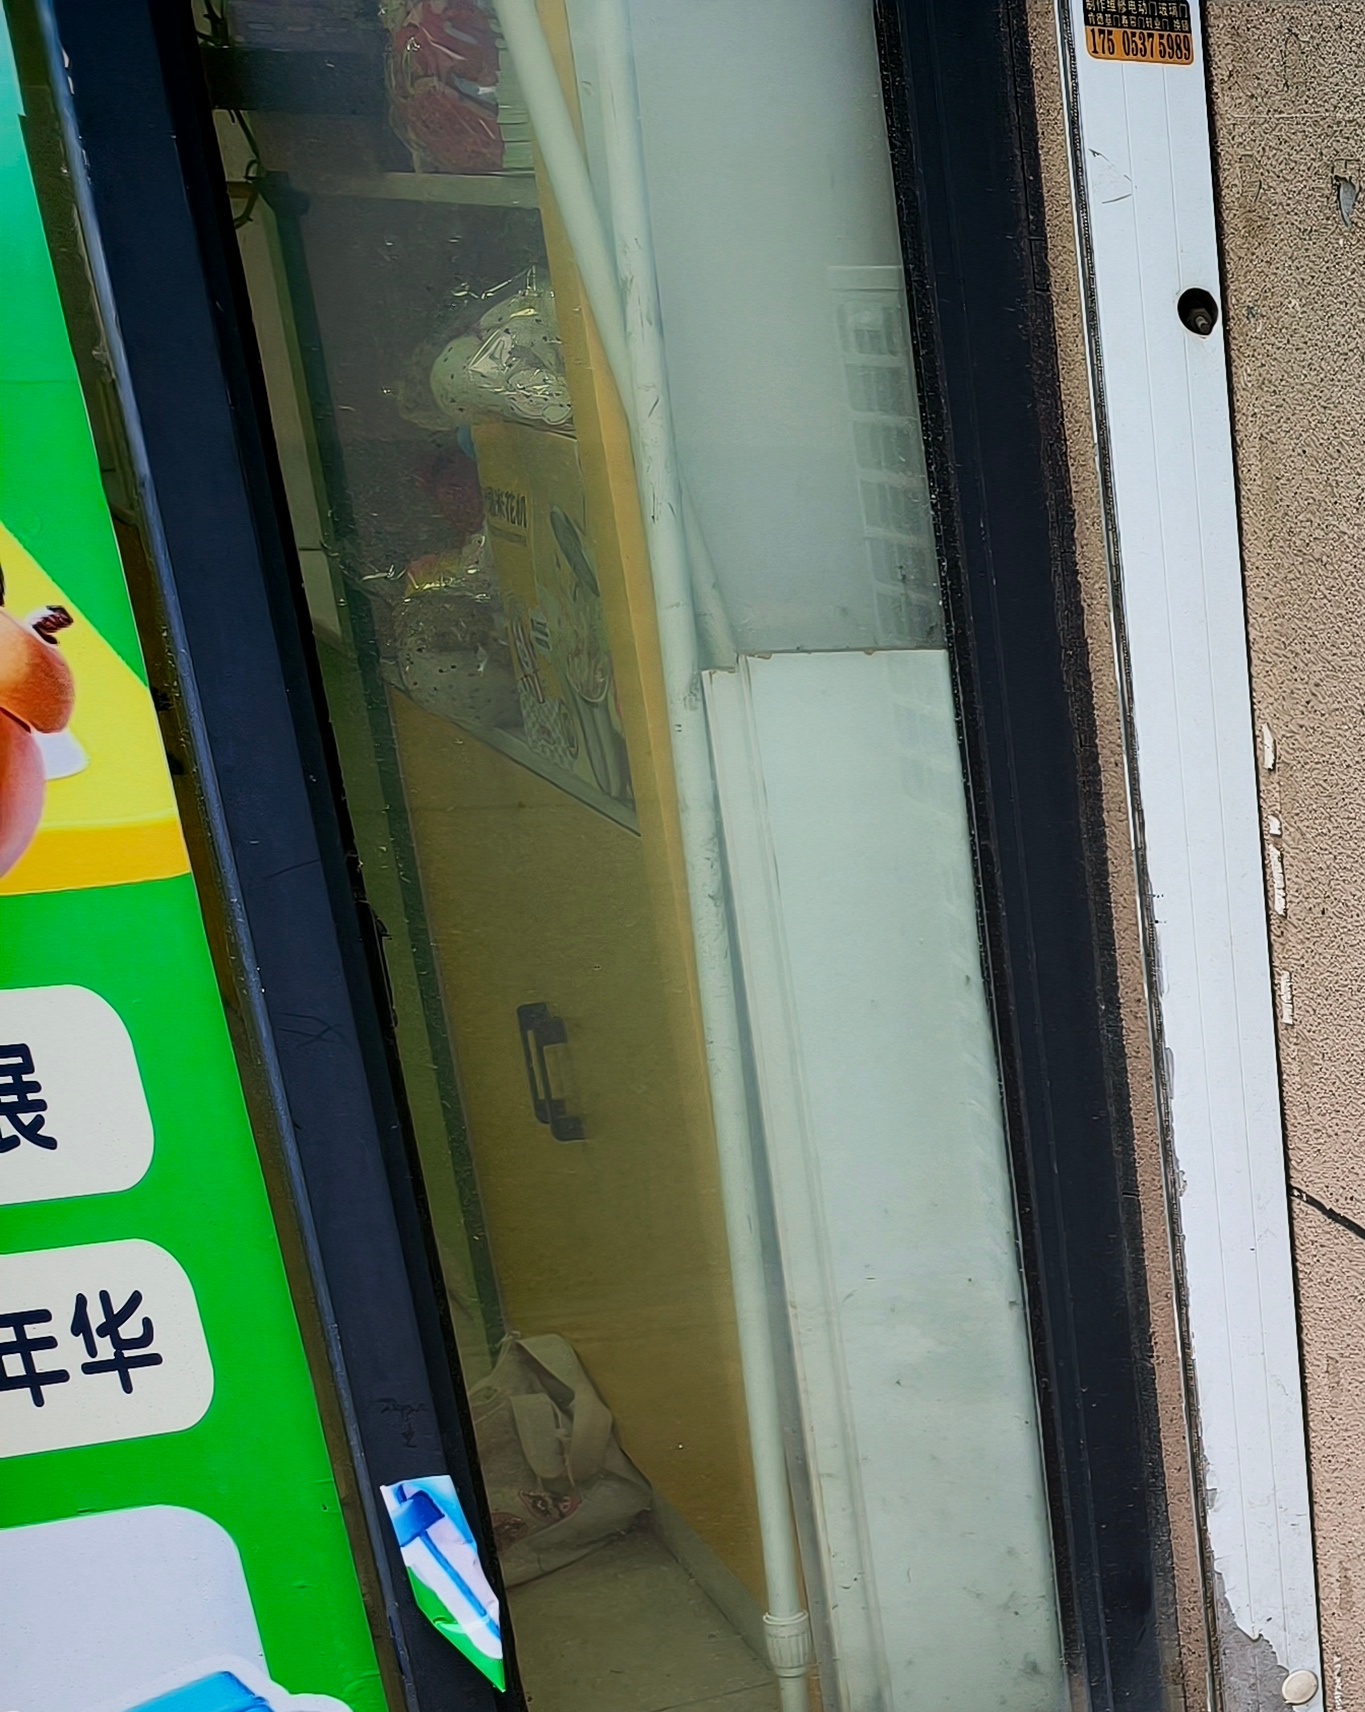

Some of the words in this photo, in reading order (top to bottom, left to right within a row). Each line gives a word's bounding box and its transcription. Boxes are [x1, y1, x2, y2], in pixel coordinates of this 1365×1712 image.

[1090, 28, 1115, 55] 175
[1122, 30, 1154, 58] 0537
[1158, 33, 1191, 60] 5989
[0, 1290, 164, 1408] 年华
